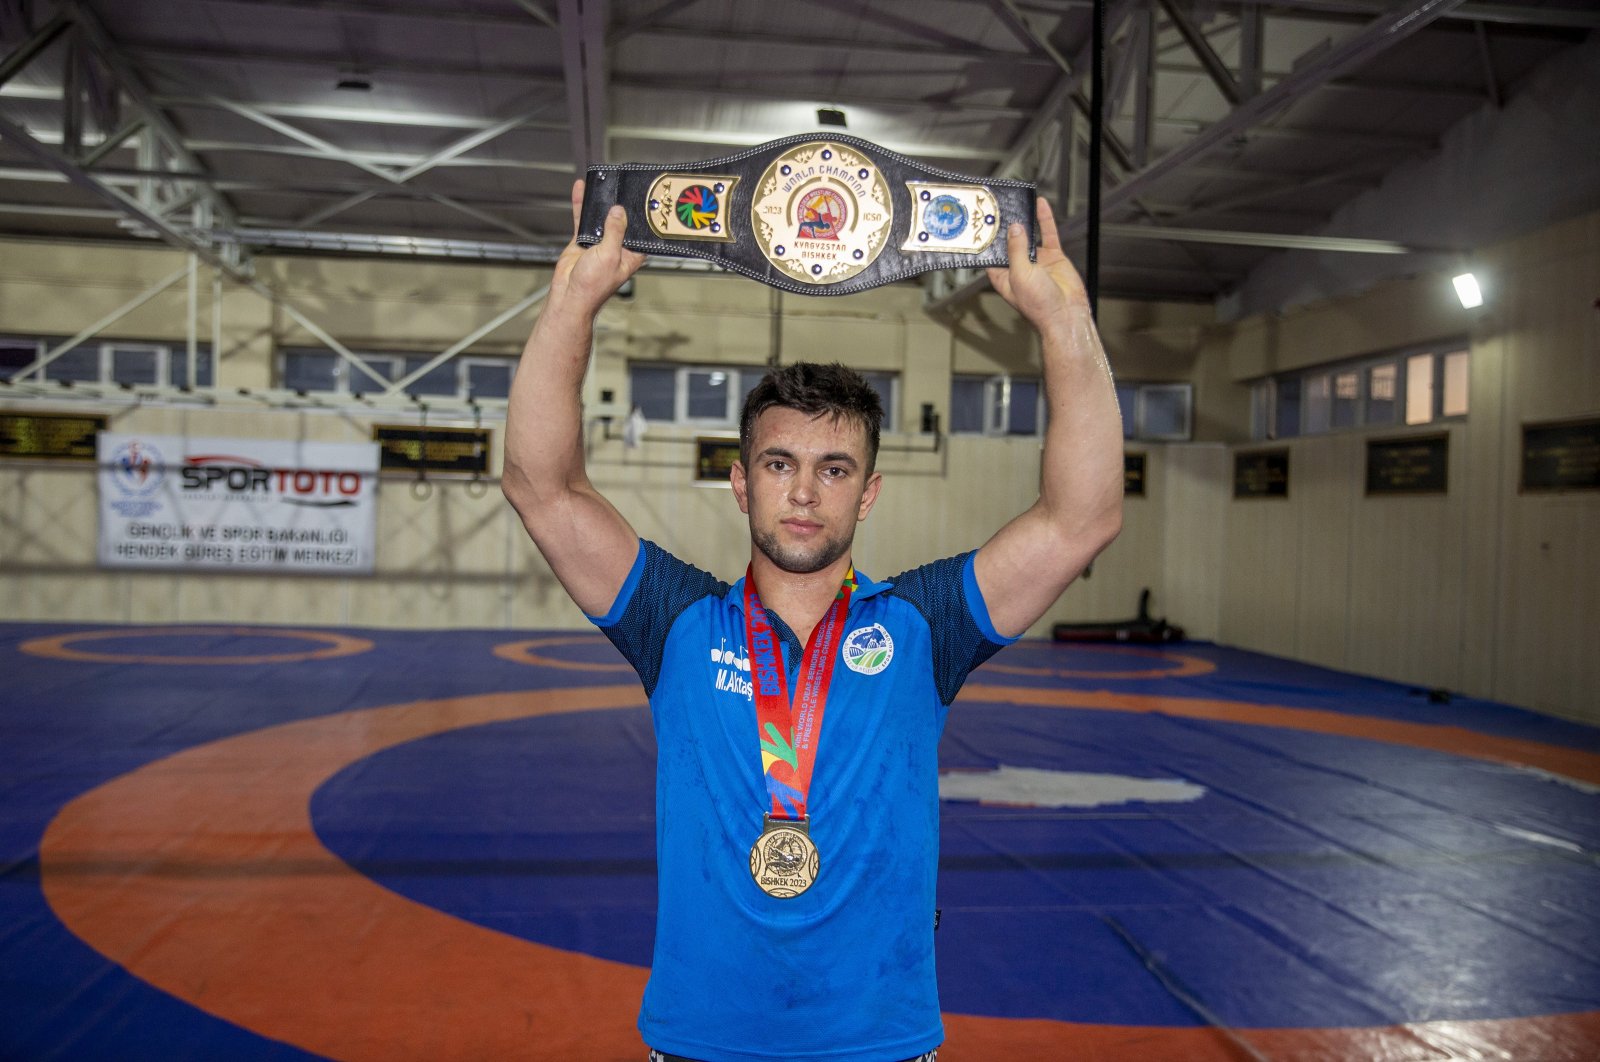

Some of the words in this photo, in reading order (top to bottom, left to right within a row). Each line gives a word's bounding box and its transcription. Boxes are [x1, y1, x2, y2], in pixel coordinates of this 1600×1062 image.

[819, 165, 866, 198] CHAMPION
[794, 241, 847, 251] KYRGYZSTAN
[801, 251, 837, 260] BISHKEK
[200, 526, 217, 539] VE
[224, 527, 263, 541] SPOR
[751, 629, 781, 696] BISHKEK
[803, 698, 817, 743] FREESTYLE
[812, 655, 827, 697] WRESTLING
[822, 602, 839, 655] CHAMPIONSHIPS
[807, 649, 820, 680] SENIORS
[715, 668, 753, 701] M.Aktaş
[803, 682, 812, 701] DEAF
[797, 704, 808, 731] WORLD
[760, 876, 788, 886] BISHKEK
[789, 878, 807, 887] 2023
